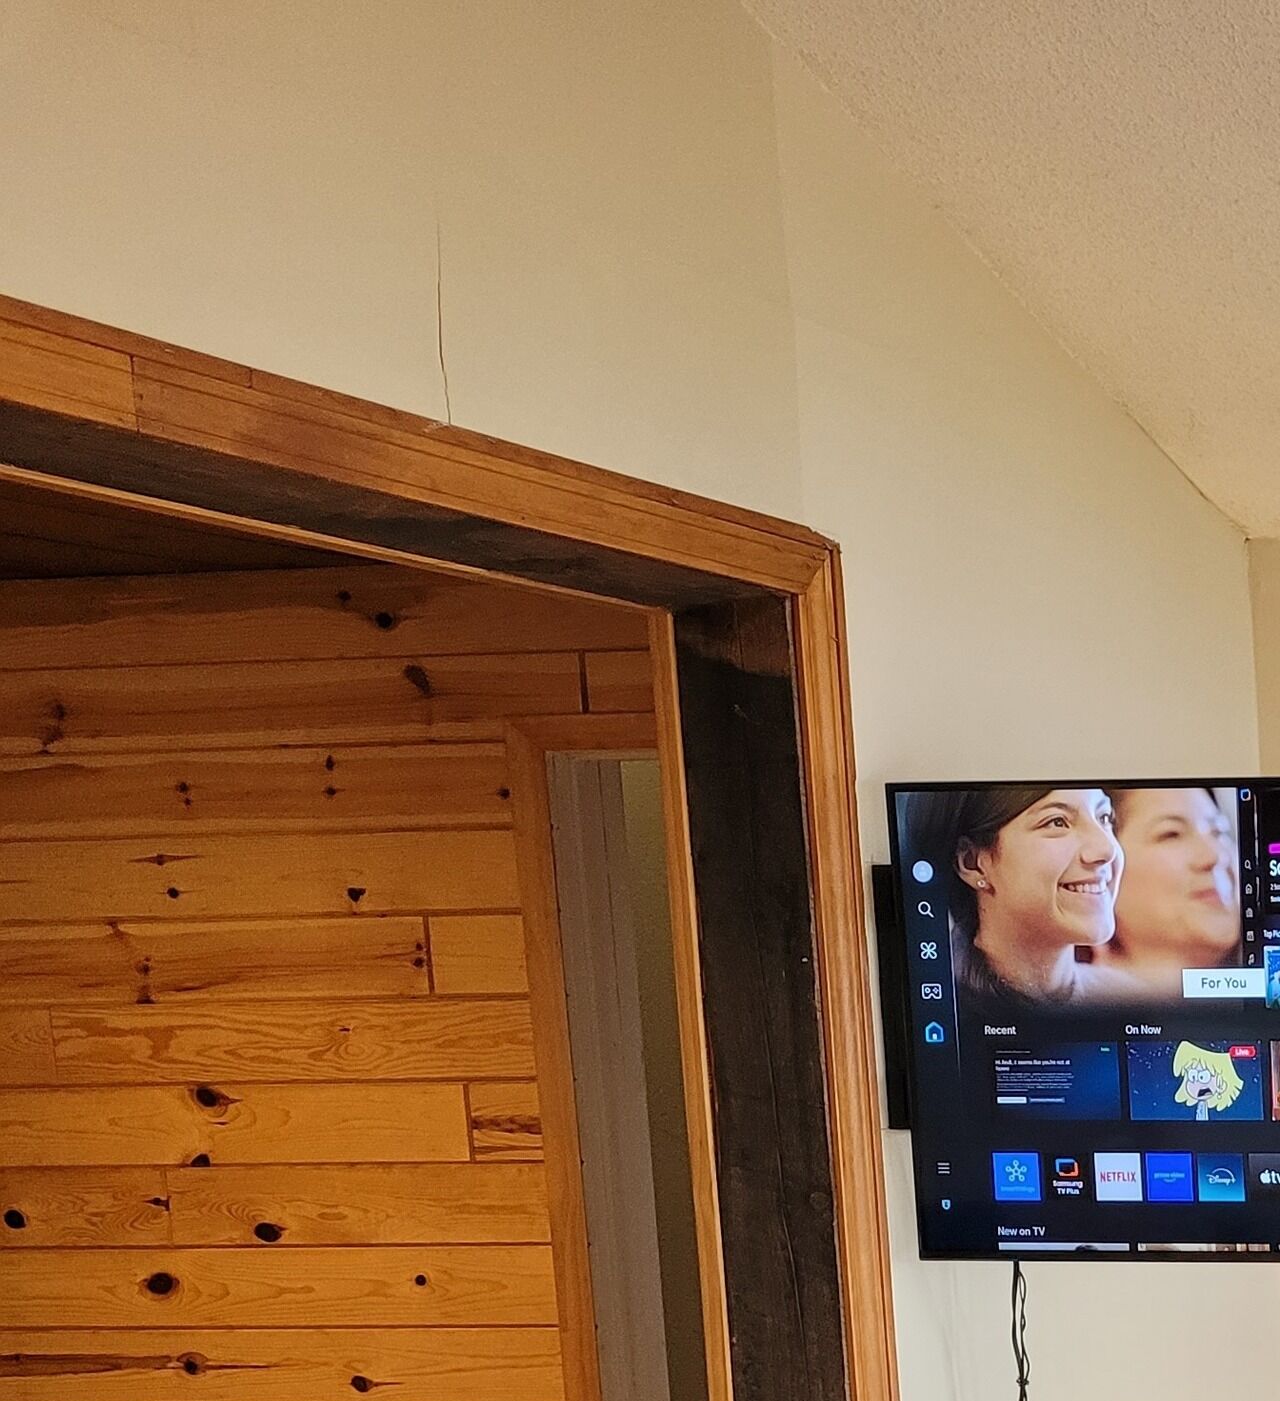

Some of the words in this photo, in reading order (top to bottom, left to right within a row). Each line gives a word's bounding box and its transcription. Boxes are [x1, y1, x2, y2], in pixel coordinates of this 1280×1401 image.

[1201, 977, 1221, 989] For
[1224, 977, 1247, 989] You
[984, 1025, 1017, 1035] Recent
[1125, 1025, 1138, 1035] On
[1140, 1025, 1161, 1035] Now
[1234, 1048, 1249, 1056] Live
[1100, 1171, 1136, 1183] NETFLIX
[998, 1226, 1017, 1236] New
[1019, 1228, 1031, 1236] on
[1032, 1226, 1045, 1236] TV
